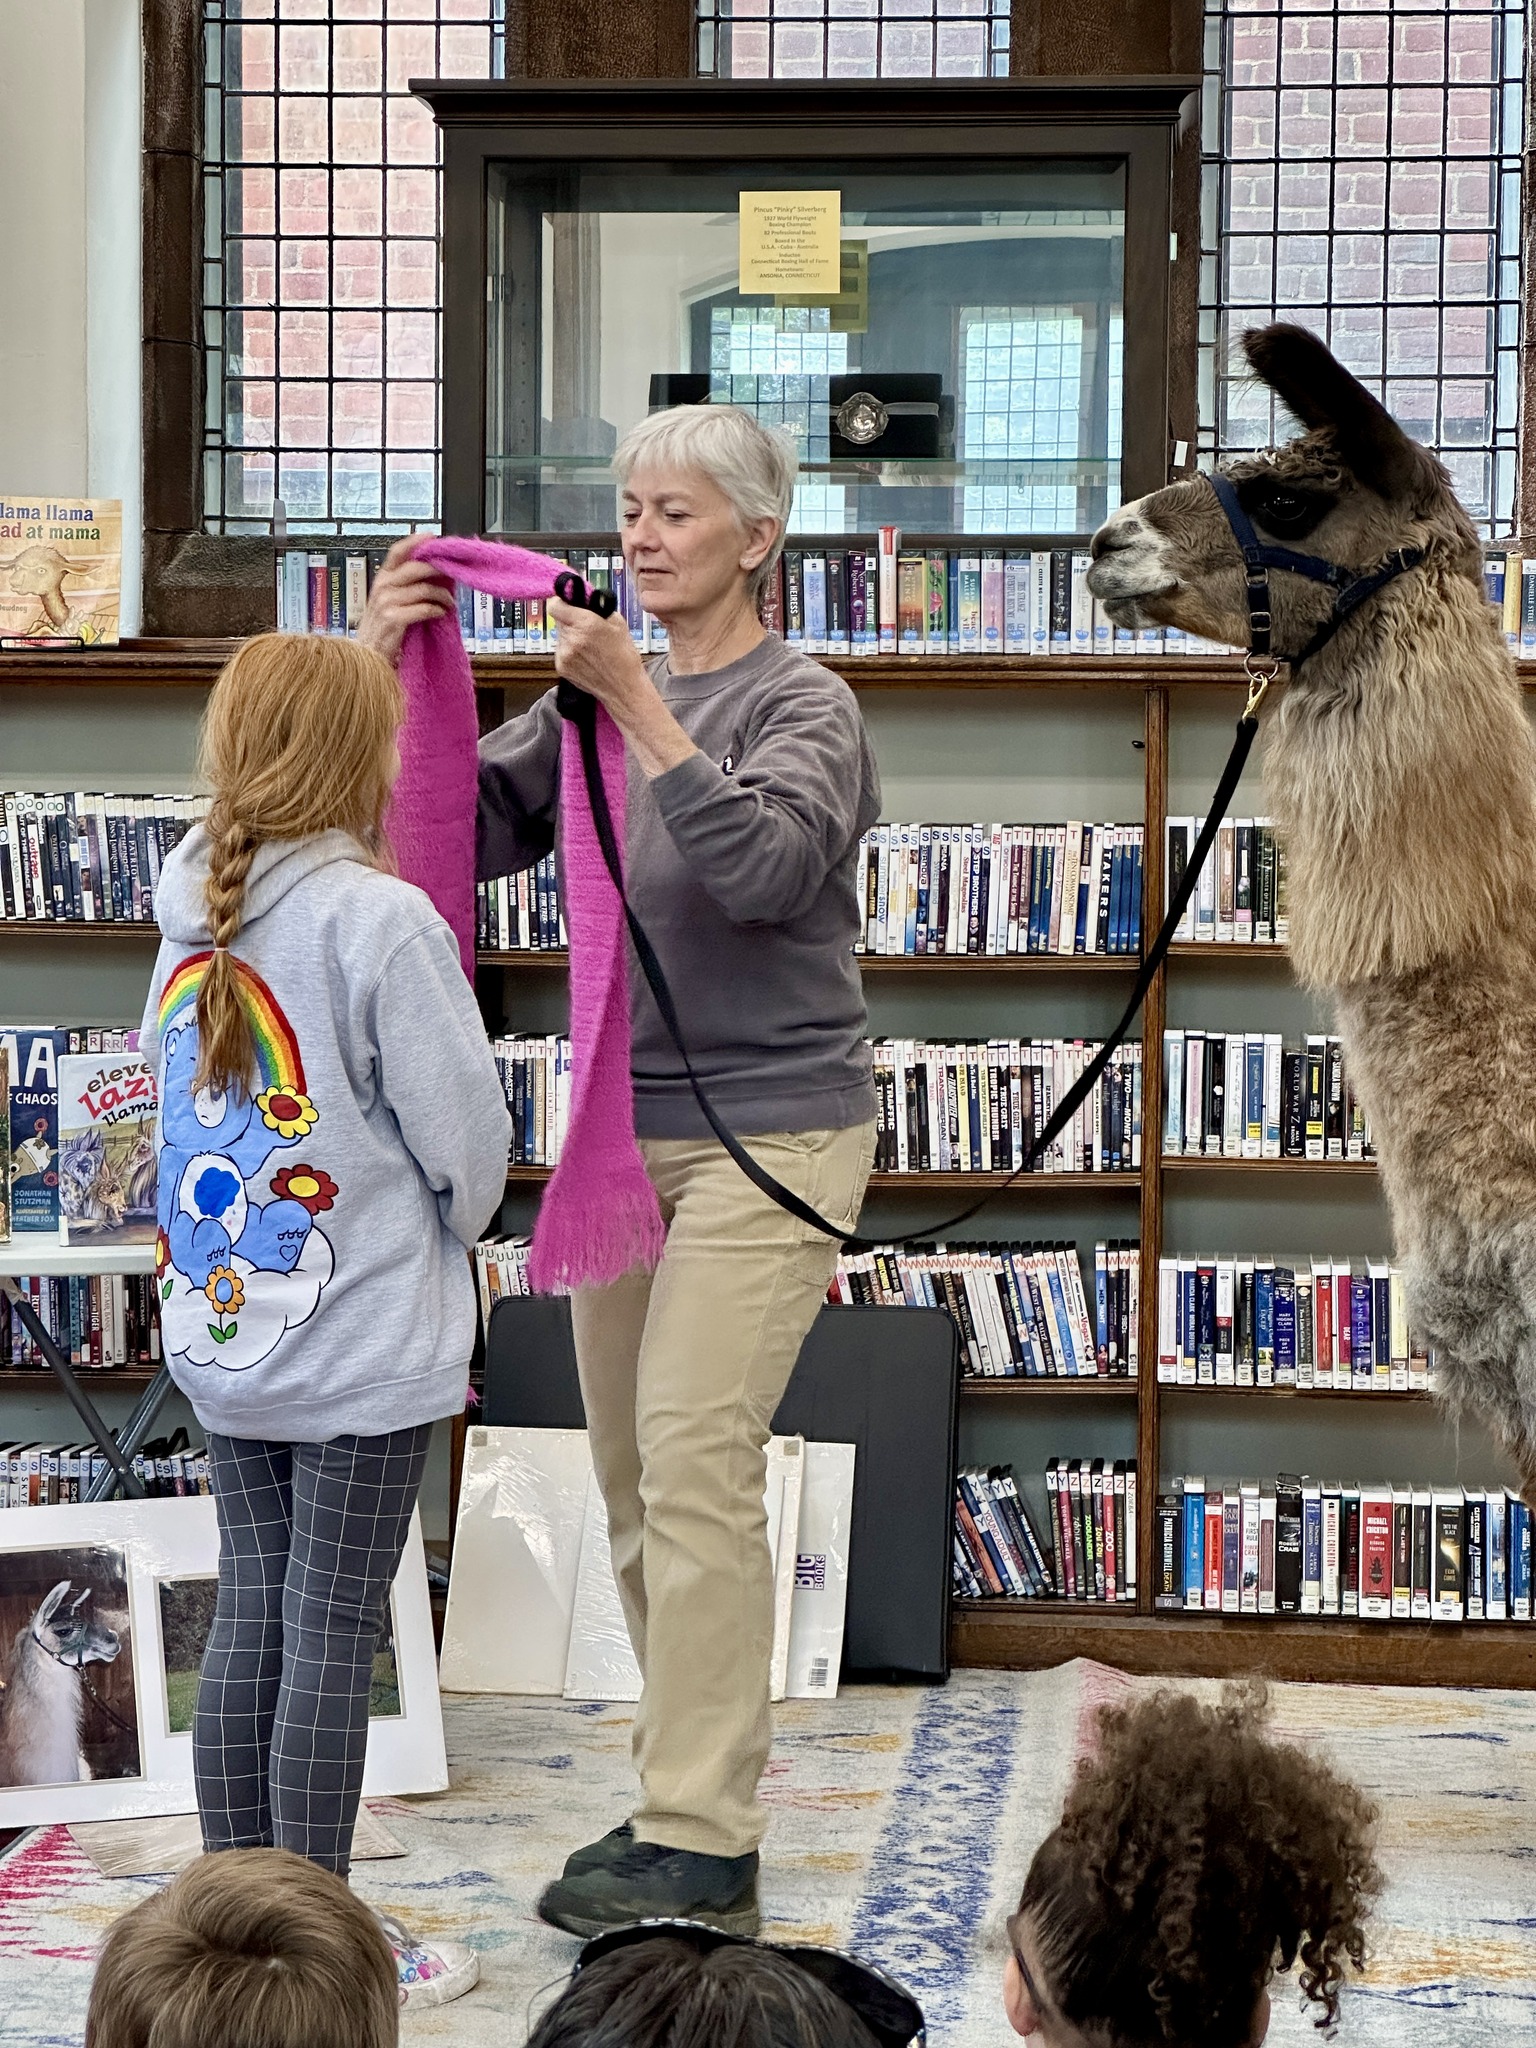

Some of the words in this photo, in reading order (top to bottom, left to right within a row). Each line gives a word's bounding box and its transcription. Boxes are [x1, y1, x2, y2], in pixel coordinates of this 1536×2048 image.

[0, 503, 41, 519] lama
[47, 505, 93, 521] llama
[1, 522, 21, 538] ad
[26, 525, 43, 538] at
[50, 526, 100, 540] mama
[332, 572, 340, 590] DAVID
[858, 571, 866, 587] Nora
[1017, 582, 1025, 591] THIS
[1017, 592, 1025, 612] STRANGE
[1528, 575, 1536, 611] DANIELLE
[332, 590, 340, 619] BALDACCI
[871, 833, 877, 841] S
[922, 833, 928, 841] S
[942, 833, 949, 841] S
[1116, 833, 1122, 841] T
[129, 841, 137, 881] PATRIOT
[1099, 852, 1112, 917] TAKERS
[113, 1040, 119, 1048] R
[938, 1051, 944, 1059] T
[1012, 1052, 1018, 1061] T
[1076, 1050, 1082, 1059] T
[88, 1061, 151, 1093] eleve
[1331, 1062, 1341, 1082] SANDRA
[989, 1068, 998, 1099] TROPIC
[1331, 1083, 1340, 1101] BROWN
[16, 1093, 57, 1105] CHAOS
[886, 1082, 895, 1130] TRAFFIC
[938, 1066, 946, 1140] TRANSSIBERIAN
[102, 1101, 158, 1127] llama
[1034, 1104, 1042, 1116] BE
[1291, 1115, 1300, 1123] Z
[991, 1102, 999, 1140] THUNDER
[1014, 1258, 1024, 1267] W
[1109, 1256, 1118, 1264] W
[1031, 1288, 1039, 1306] WEST
[91, 1312, 99, 1331] TIGER
[1081, 1317, 1090, 1343] Vegas
[1343, 1326, 1351, 1341] DEAR
[31, 1462, 38, 1470] S
[72, 1464, 78, 1472] S
[198, 1464, 204, 1473] S
[1048, 1476, 1056, 1484] Y
[1117, 1480, 1122, 1488] Z
[1164, 1518, 1173, 1542] PATRICIA
[1327, 1513, 1335, 1537] MICHAEL
[1366, 1526, 1388, 1534] CRICHTON
[1367, 1517, 1387, 1525] MICHAEL
[983, 1510, 999, 1538] YOUNG
[995, 1539, 1010, 1562] ADULT
[1085, 1514, 1093, 1560] ZOOLANDER
[1105, 1531, 1114, 1552] ZOO
[1164, 1543, 1173, 1571] CORNWELL
[1327, 1540, 1335, 1566] CRICHTON
[795, 1555, 815, 1589] BIG
[815, 1555, 826, 1590] BOOKS
